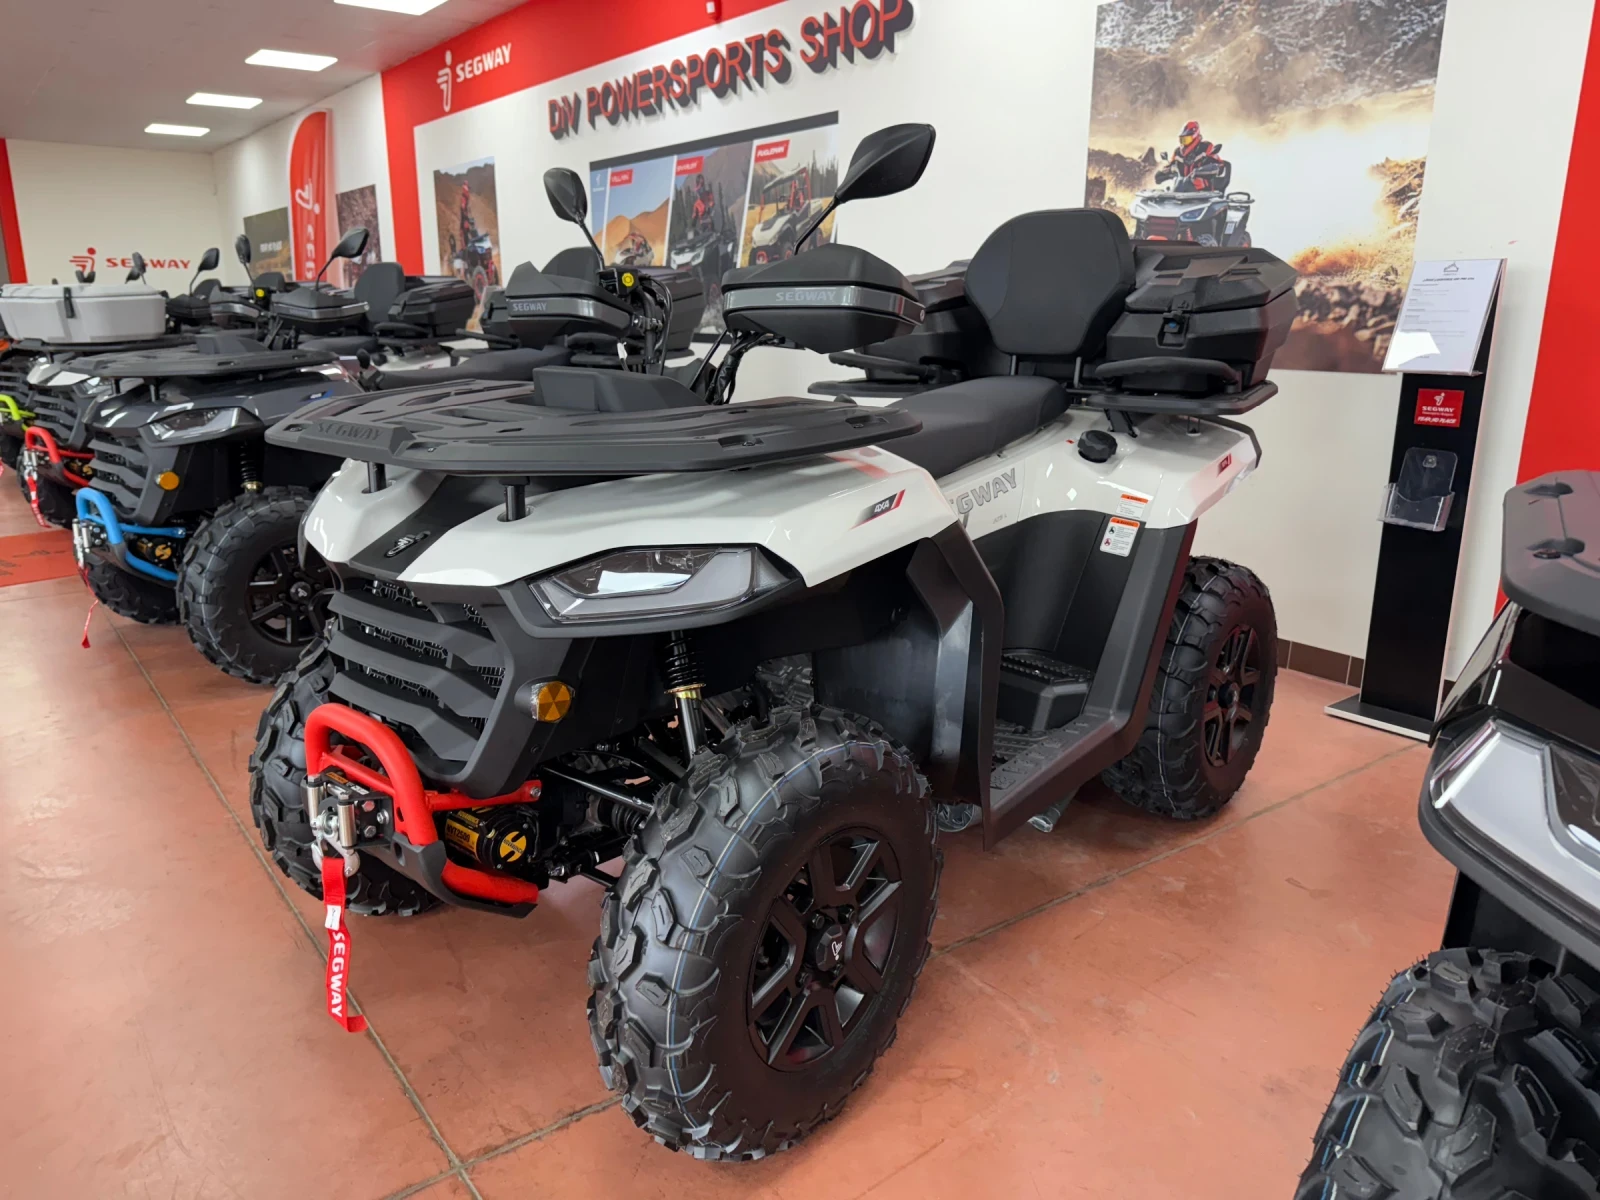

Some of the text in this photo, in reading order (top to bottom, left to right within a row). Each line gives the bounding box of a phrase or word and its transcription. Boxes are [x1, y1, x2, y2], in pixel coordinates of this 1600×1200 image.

[456, 42, 512, 83] SEGWAY
[586, 29, 791, 130] POWERSPORTS
[800, 0, 911, 72] SHOP
[105, 257, 191, 270] SEWAY
[775, 290, 837, 302] SEGWAY
[512, 302, 547, 312] SEGWAY
[318, 422, 384, 441] SEGWAY
[950, 467, 1017, 515] GWAY
[874, 499, 891, 513] 4X4
[329, 931, 347, 1018] SEGWAY
